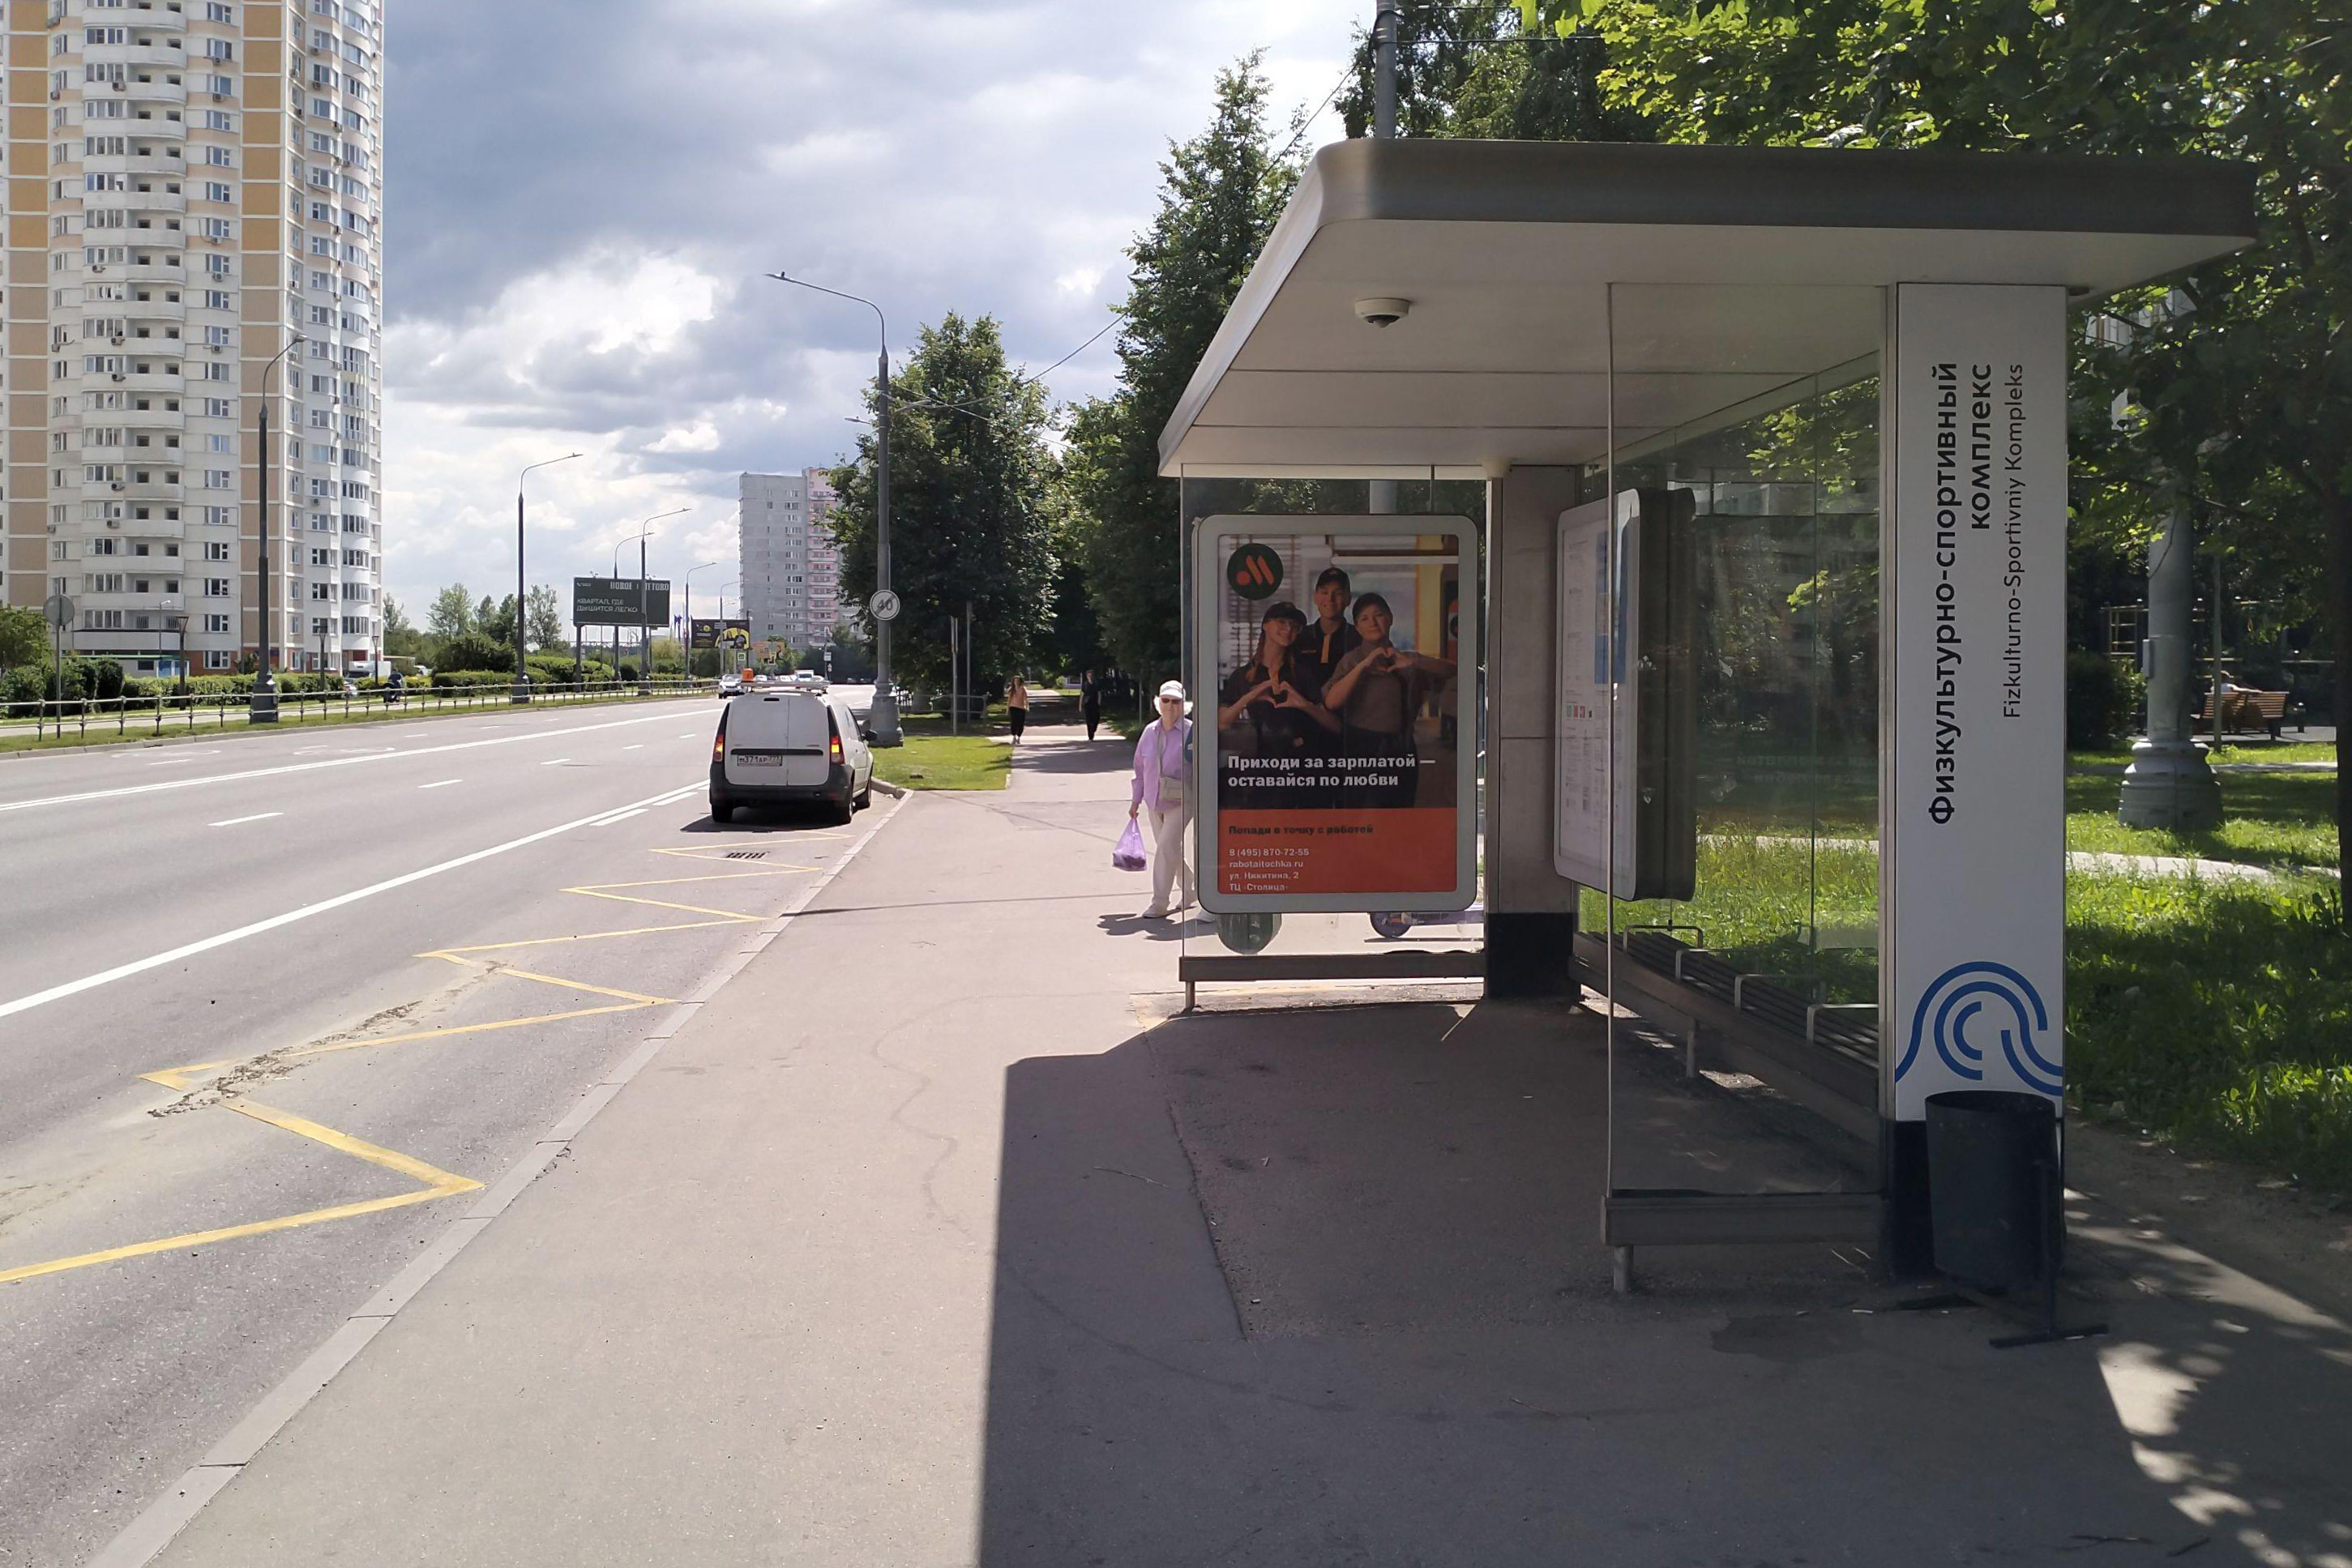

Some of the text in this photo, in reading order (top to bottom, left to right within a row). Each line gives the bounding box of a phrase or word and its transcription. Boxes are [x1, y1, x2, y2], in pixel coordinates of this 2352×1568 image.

[1971, 364, 1991, 530] комплекс
[2003, 364, 2026, 718] Fizkulturno-Sportivniy Kompleks
[1928, 363, 1962, 825] Физкультурно-спортивный
[878, 599, 892, 610] 40
[1228, 755, 1300, 771] Приходи
[1305, 758, 1324, 768] за
[1328, 754, 1415, 771] зарплатой
[1228, 773, 1399, 787] оставайся по любви
[1229, 825, 1271, 835] Попади
[1284, 827, 1314, 835] точку
[1327, 824, 1374, 835] работой
[1238, 848, 1261, 857] (495)
[1293, 871, 1299, 879] 2
[1229, 882, 1242, 892] ТЦ
